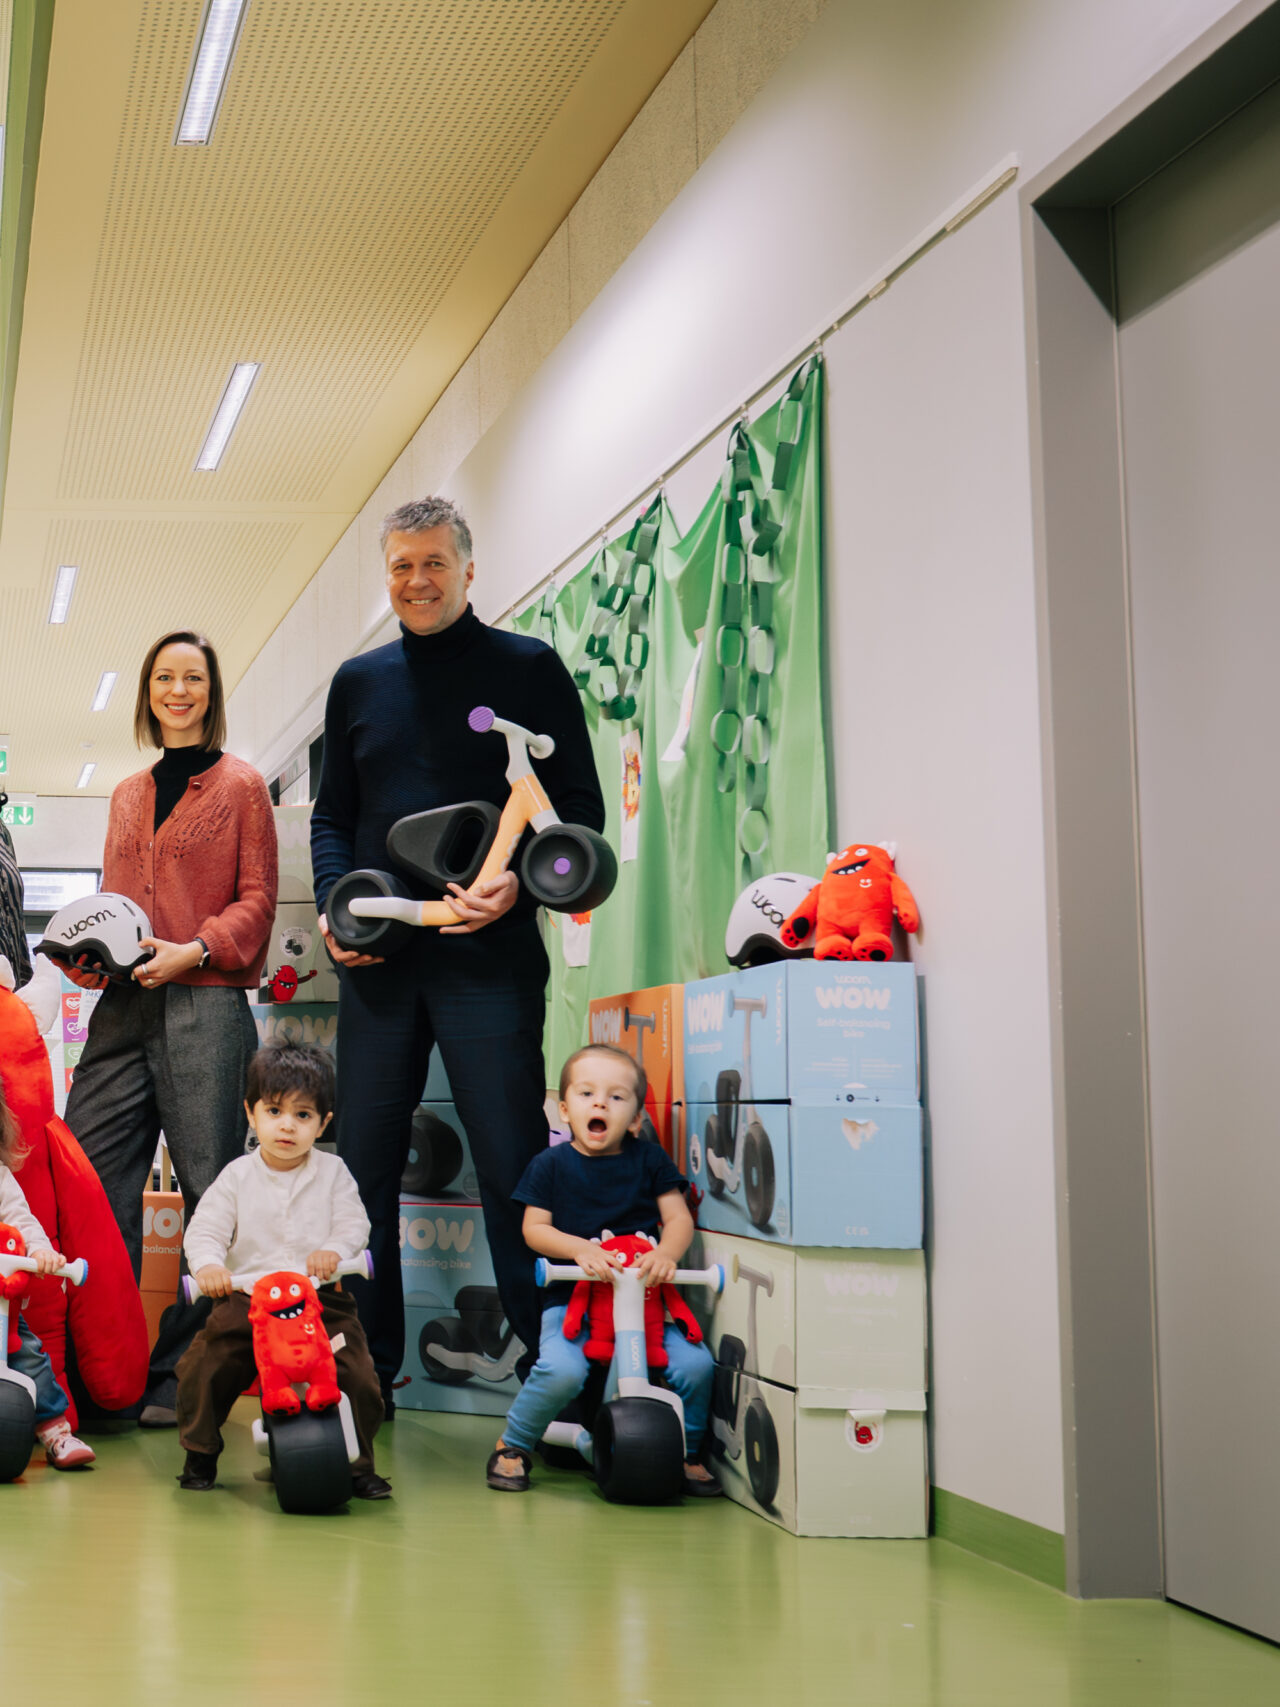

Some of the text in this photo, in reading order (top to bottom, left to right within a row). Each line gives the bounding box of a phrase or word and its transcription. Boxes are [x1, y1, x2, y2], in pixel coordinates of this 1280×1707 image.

[61, 909, 117, 940] woom
[751, 889, 787, 929] woo
[687, 989, 726, 1036] WOW
[815, 986, 892, 1011] WOW
[591, 1007, 622, 1044] WOW
[399, 1216, 474, 1253] OW
[449, 1258, 472, 1270] bike
[823, 1273, 899, 1298] WOW
[630, 1335, 641, 1372] woom
